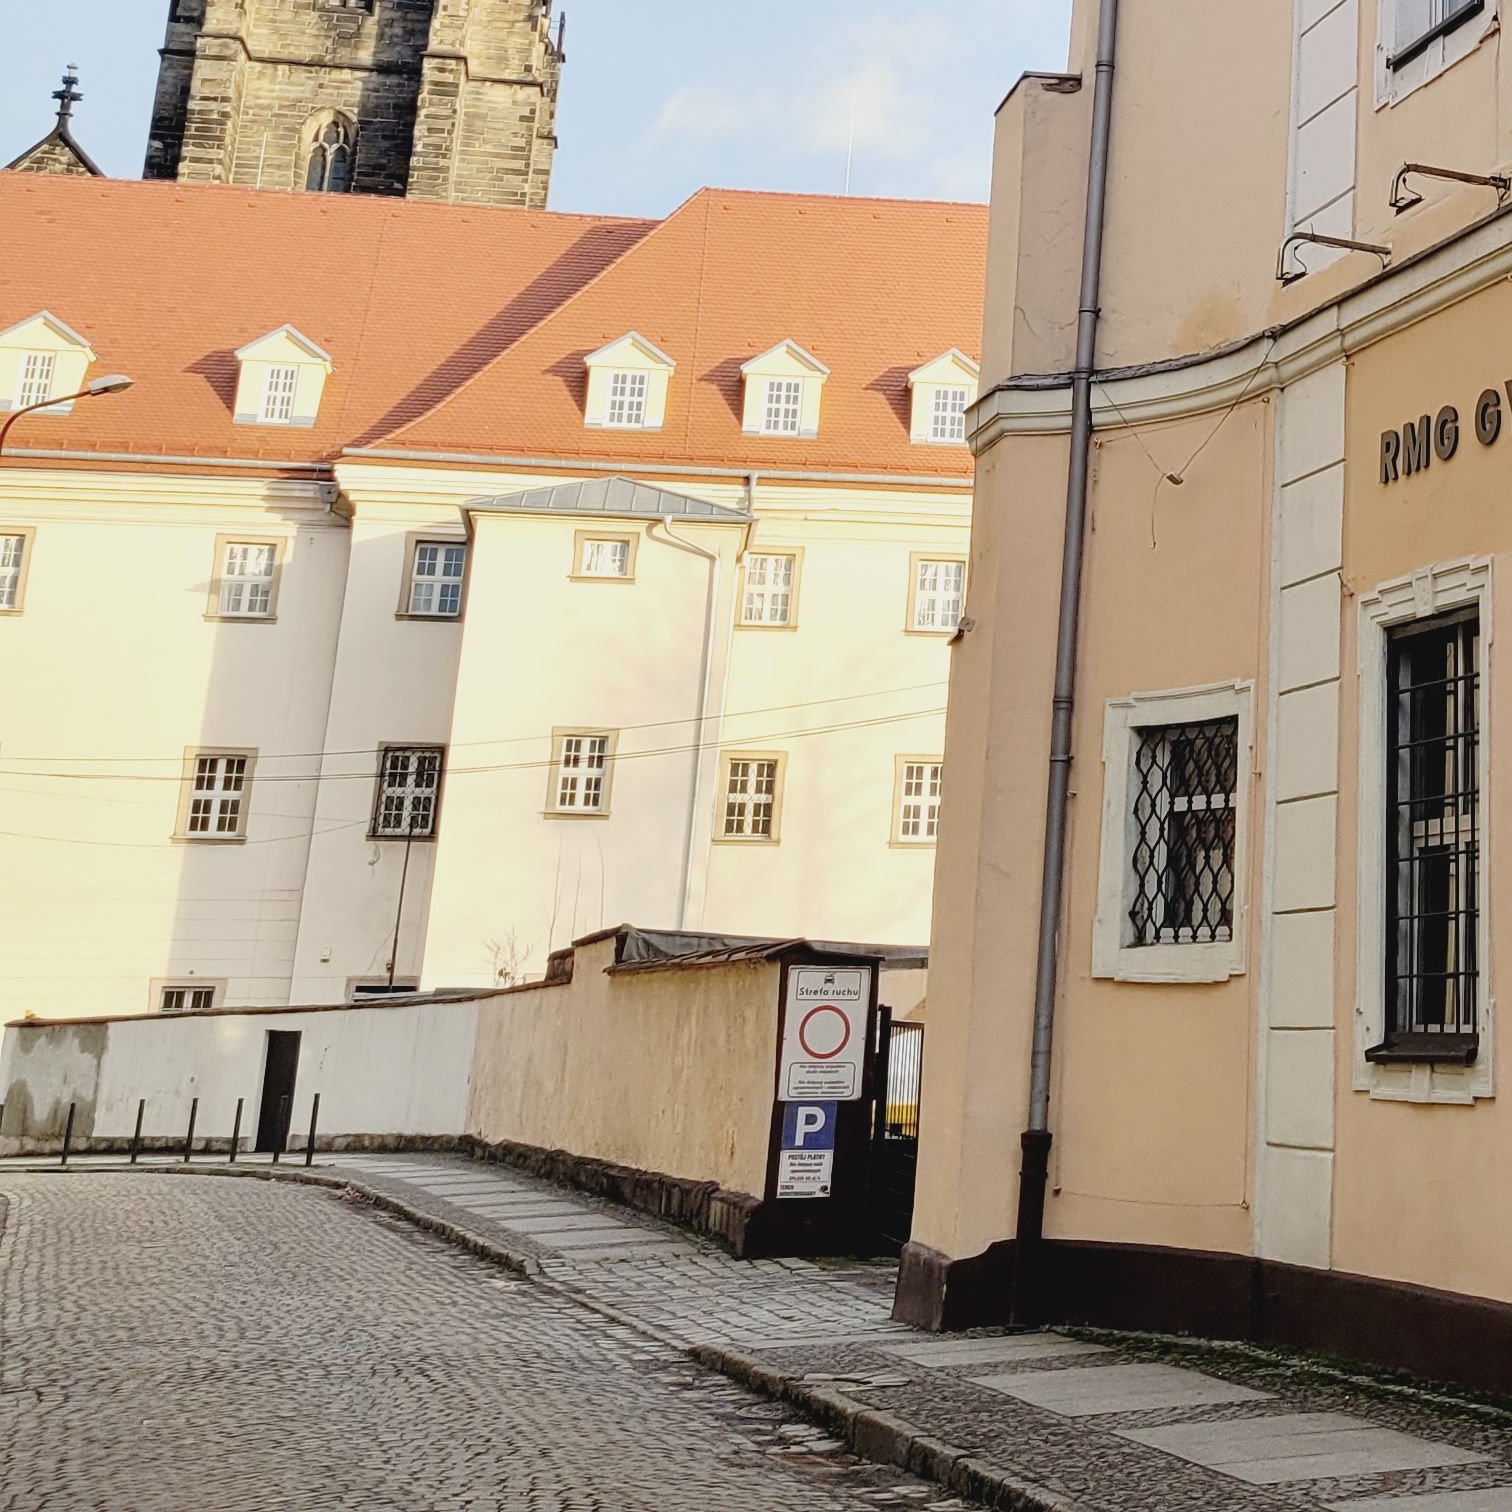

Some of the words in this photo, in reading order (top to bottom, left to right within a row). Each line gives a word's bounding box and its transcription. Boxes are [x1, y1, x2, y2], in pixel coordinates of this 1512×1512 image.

[1379, 404, 1460, 486] RMG
[799, 987, 829, 996] Strefa
[832, 988, 859, 996] ruchu
[794, 1106, 826, 1146] P
